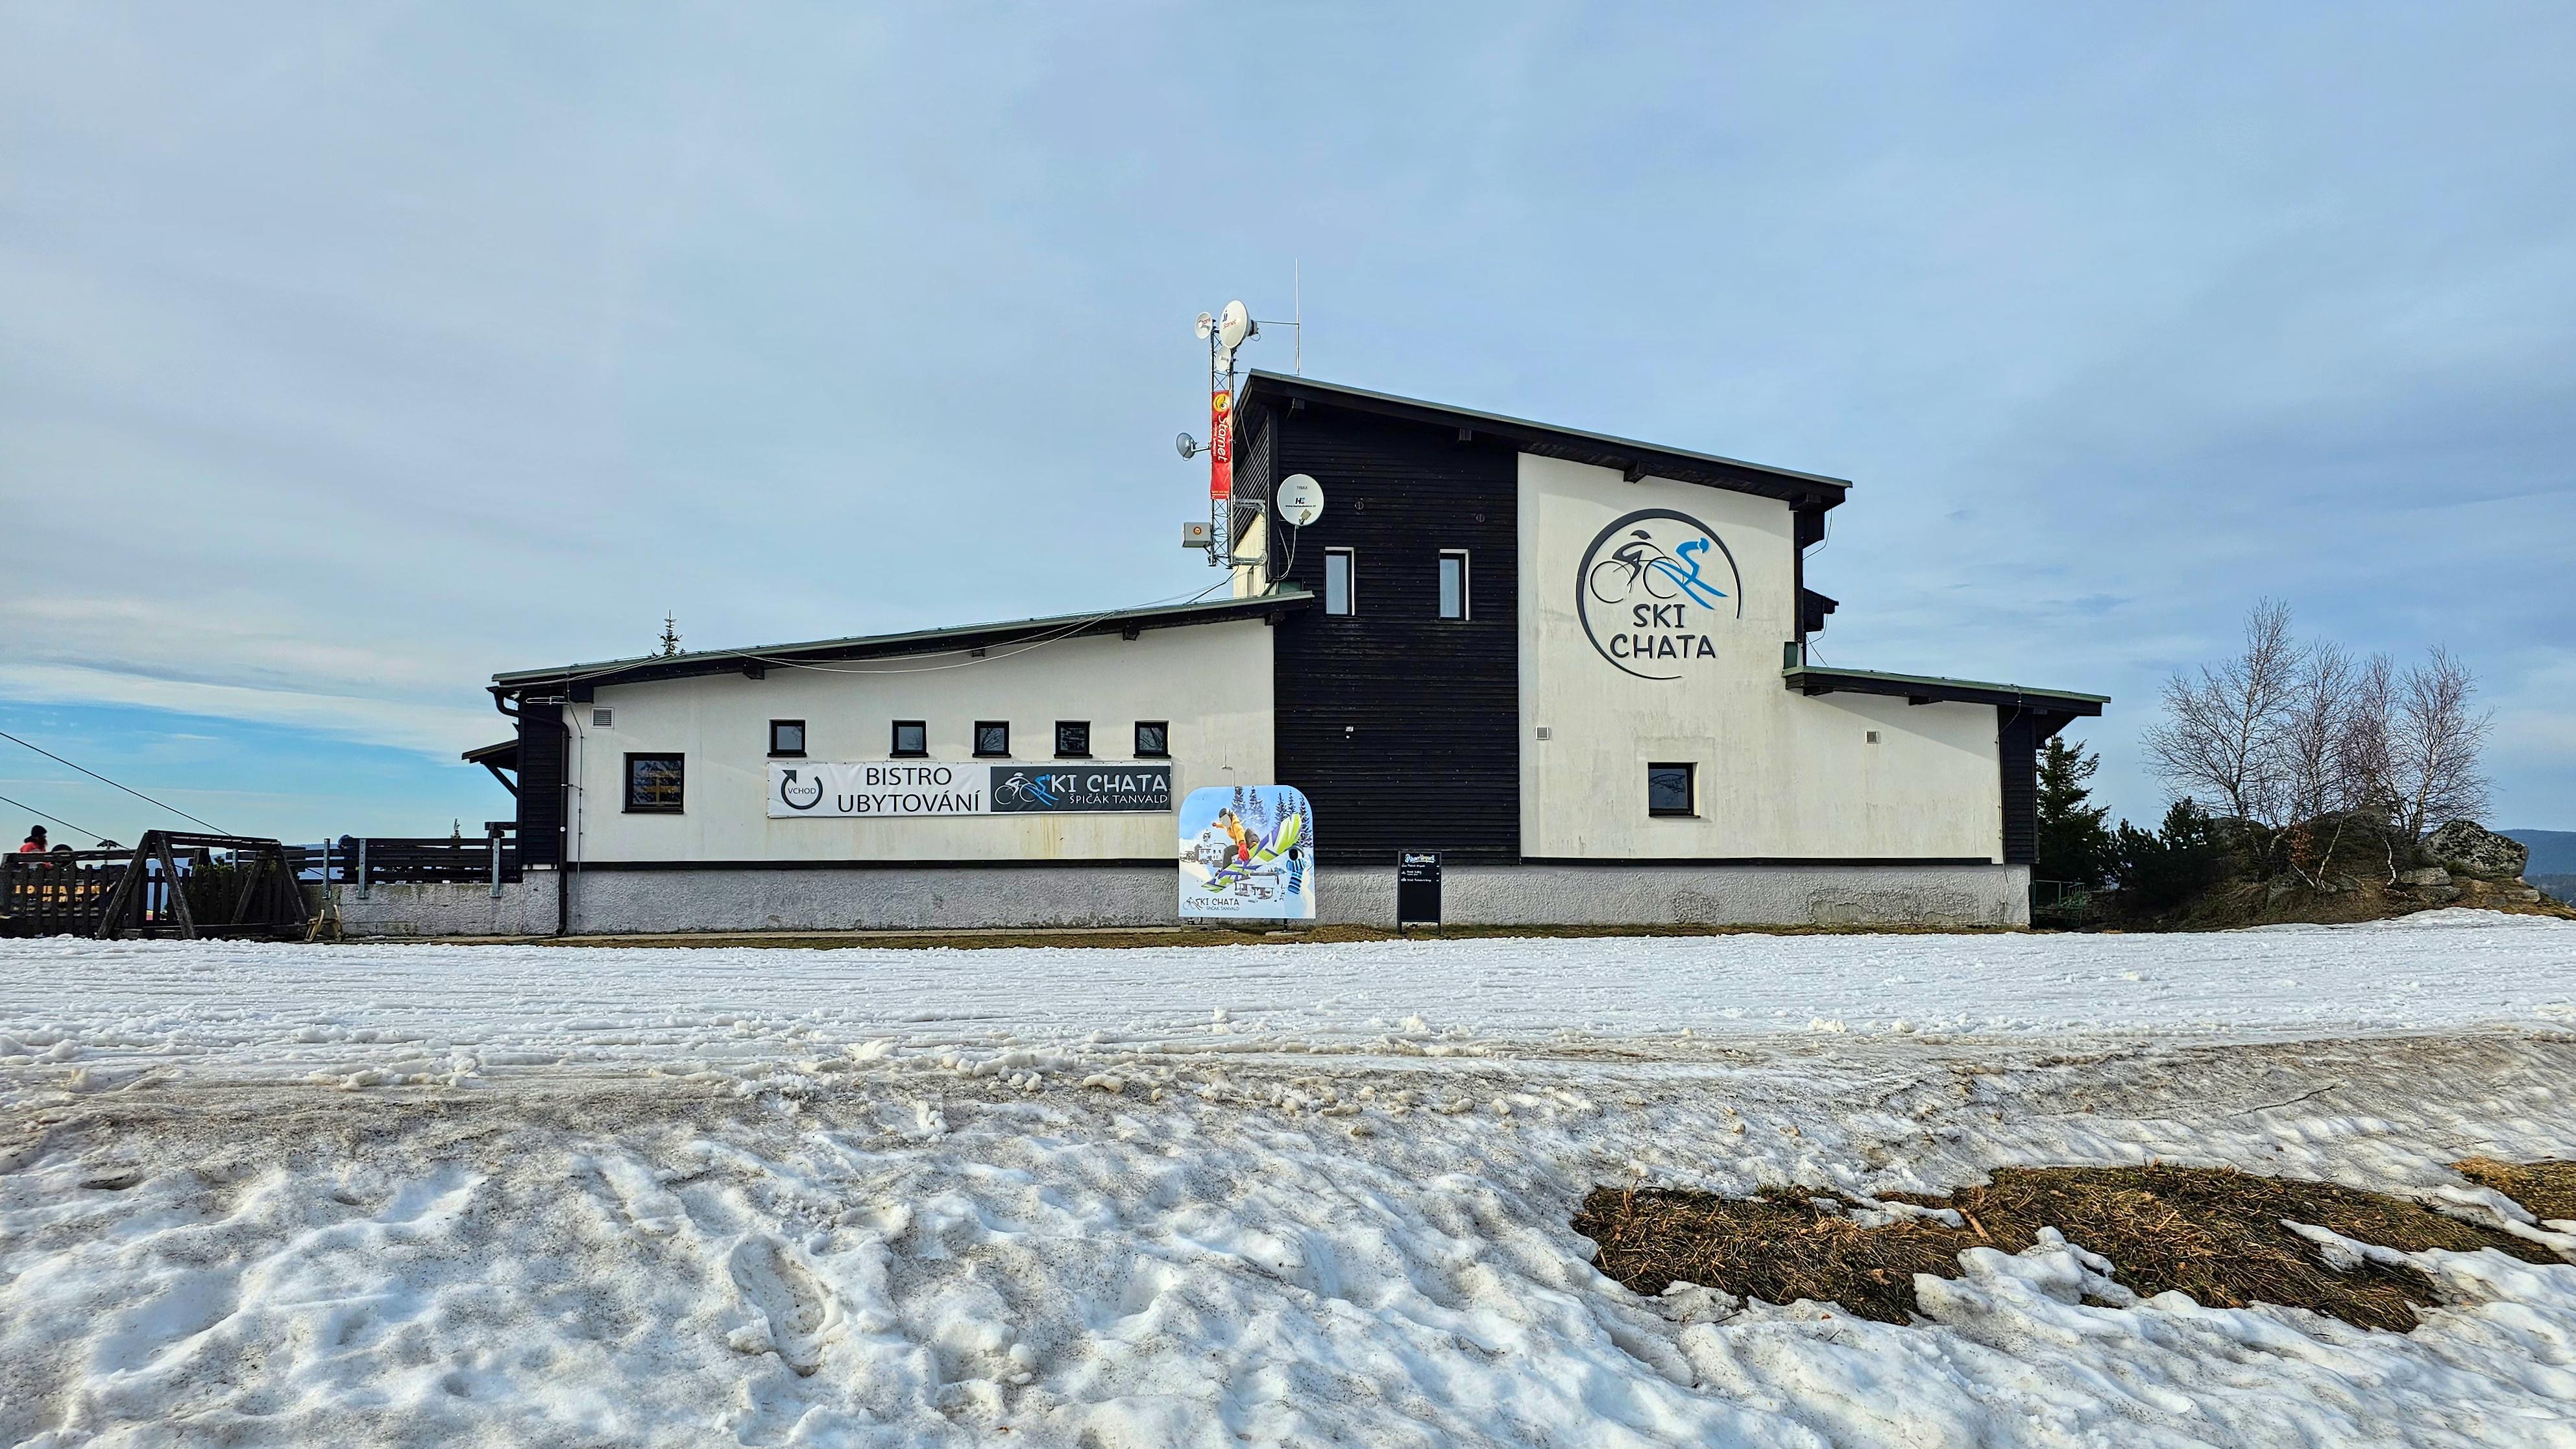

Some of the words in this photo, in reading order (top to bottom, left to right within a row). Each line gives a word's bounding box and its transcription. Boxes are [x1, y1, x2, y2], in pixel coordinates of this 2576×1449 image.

[1633, 603, 1686, 628] SKI
[1609, 633, 1716, 659] CHATA
[866, 767, 952, 786] BISTRO
[1086, 774, 1168, 793] CHATA
[837, 790, 981, 812] UBYTOVÁNÍ
[1069, 793, 1110, 804] ŠPIČÁK
[1112, 794, 1168, 804] TANVALD
[1211, 897, 1240, 906] CHATA
